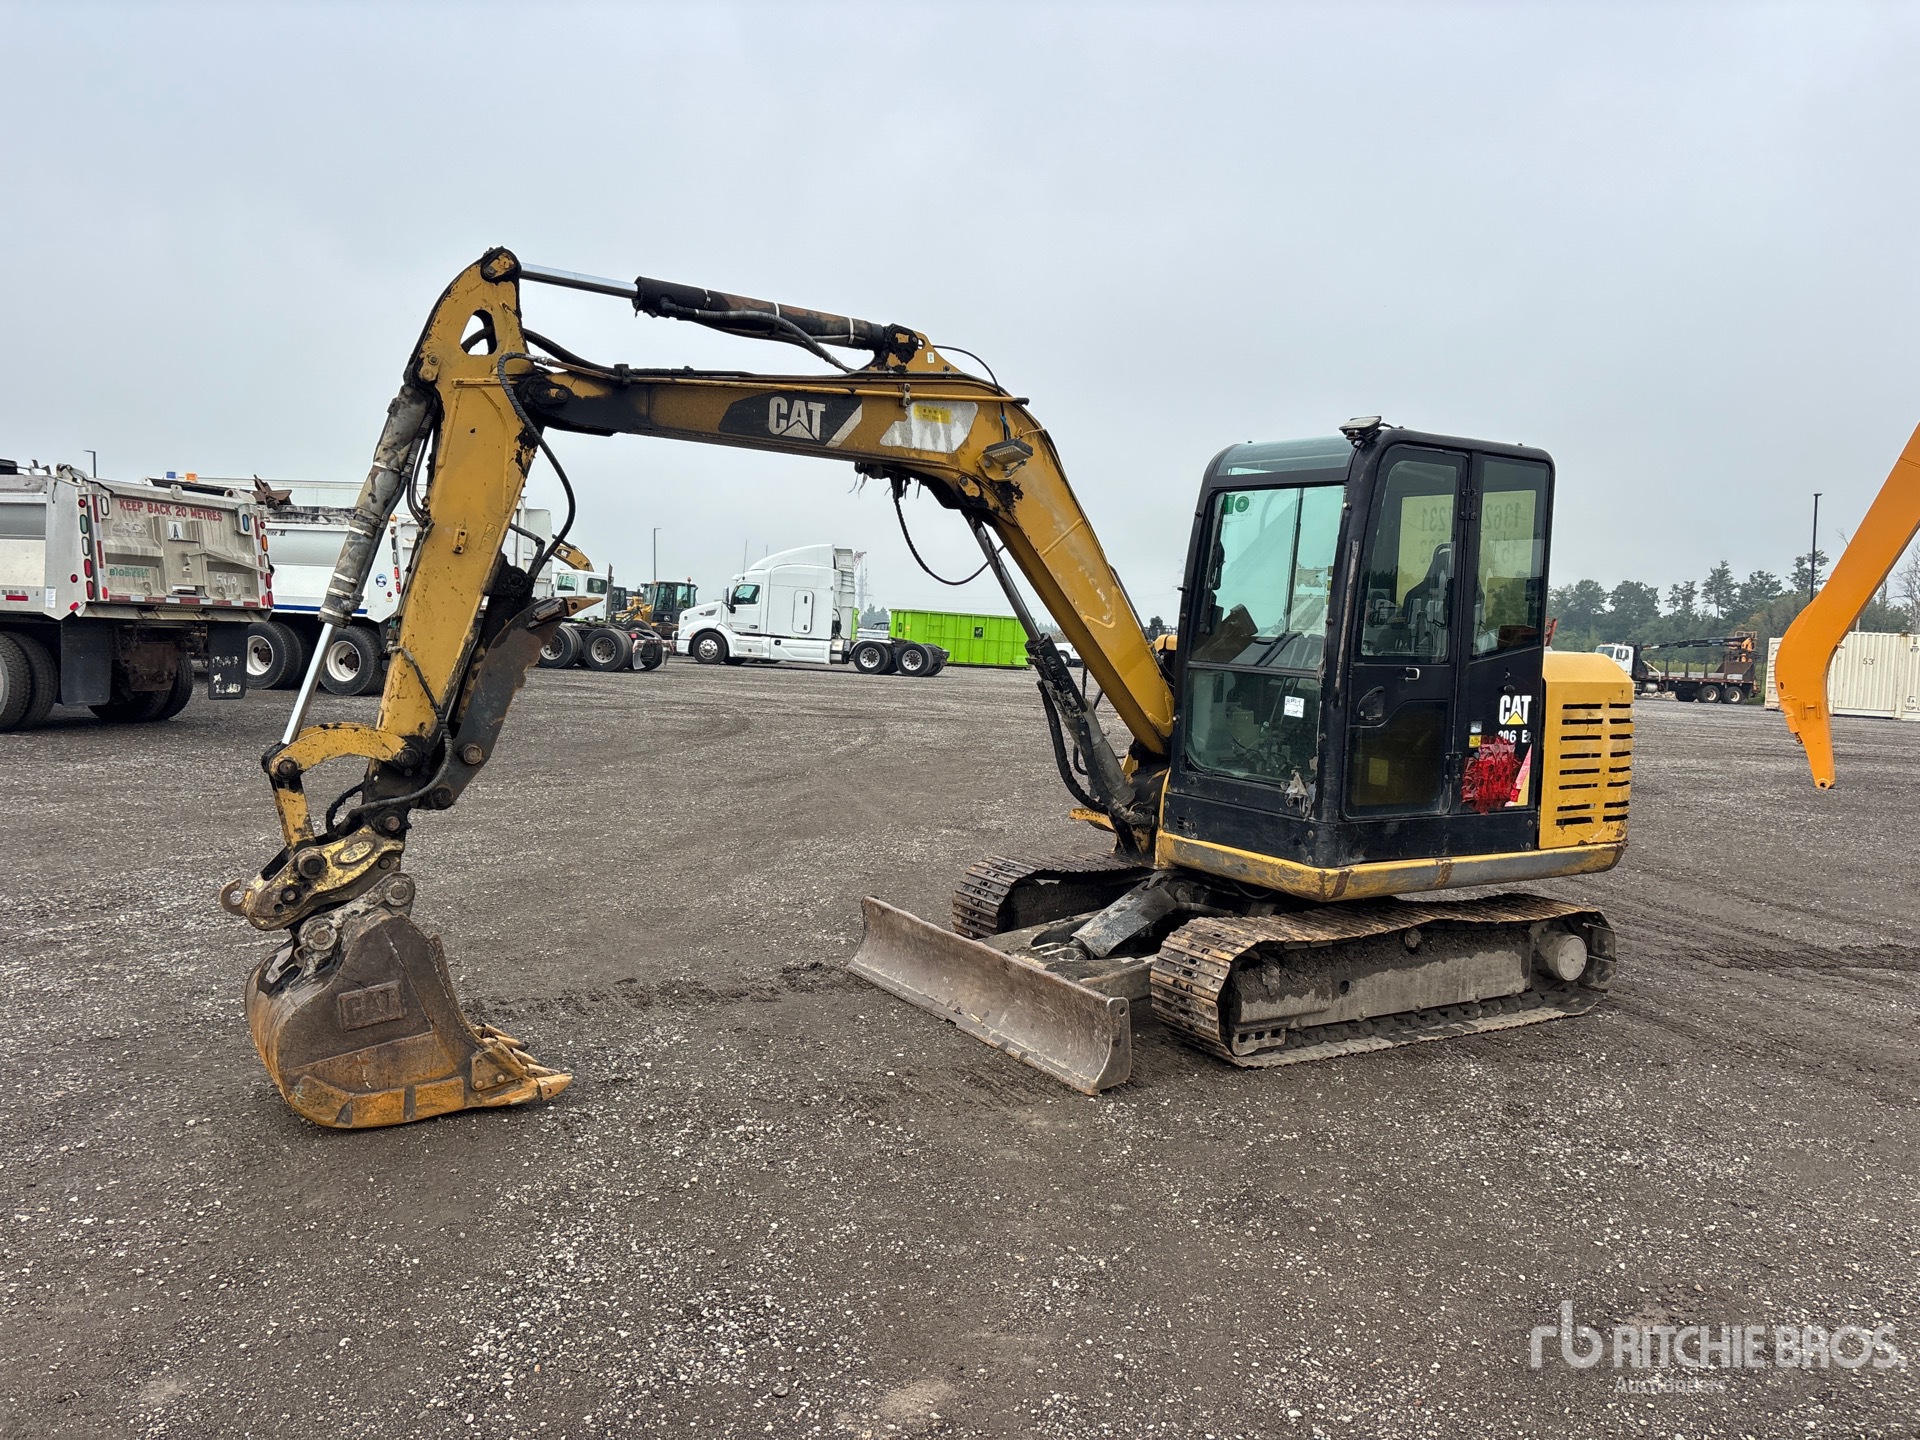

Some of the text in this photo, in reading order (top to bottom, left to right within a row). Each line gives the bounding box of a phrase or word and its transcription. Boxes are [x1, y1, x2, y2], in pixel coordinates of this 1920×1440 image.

[769, 396, 826, 441] CAT
[120, 498, 223, 522] KEEP BACK 20 METRES
[1499, 695, 1532, 725] CAT
